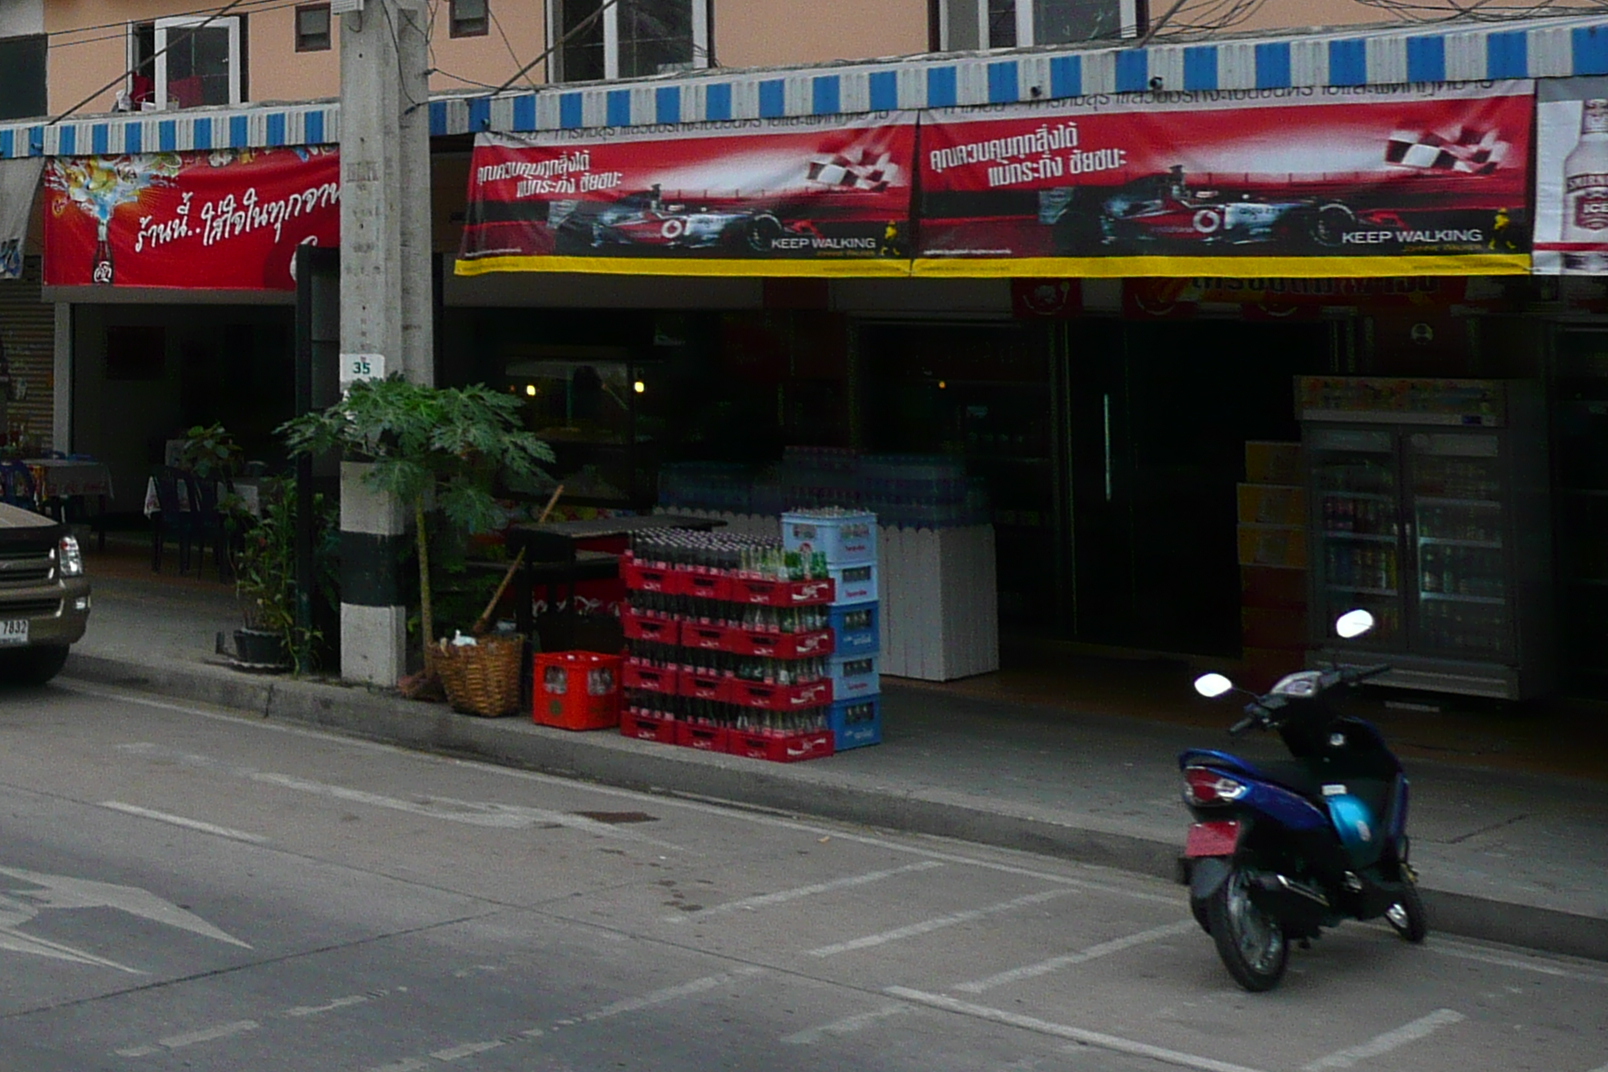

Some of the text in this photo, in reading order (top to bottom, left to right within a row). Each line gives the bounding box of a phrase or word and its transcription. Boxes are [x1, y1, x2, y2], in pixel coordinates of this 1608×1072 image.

[771, 237, 877, 249] KEEP WALKING
[1341, 229, 1483, 244] KEEP WALKING
[353, 362, 371, 375] 35
